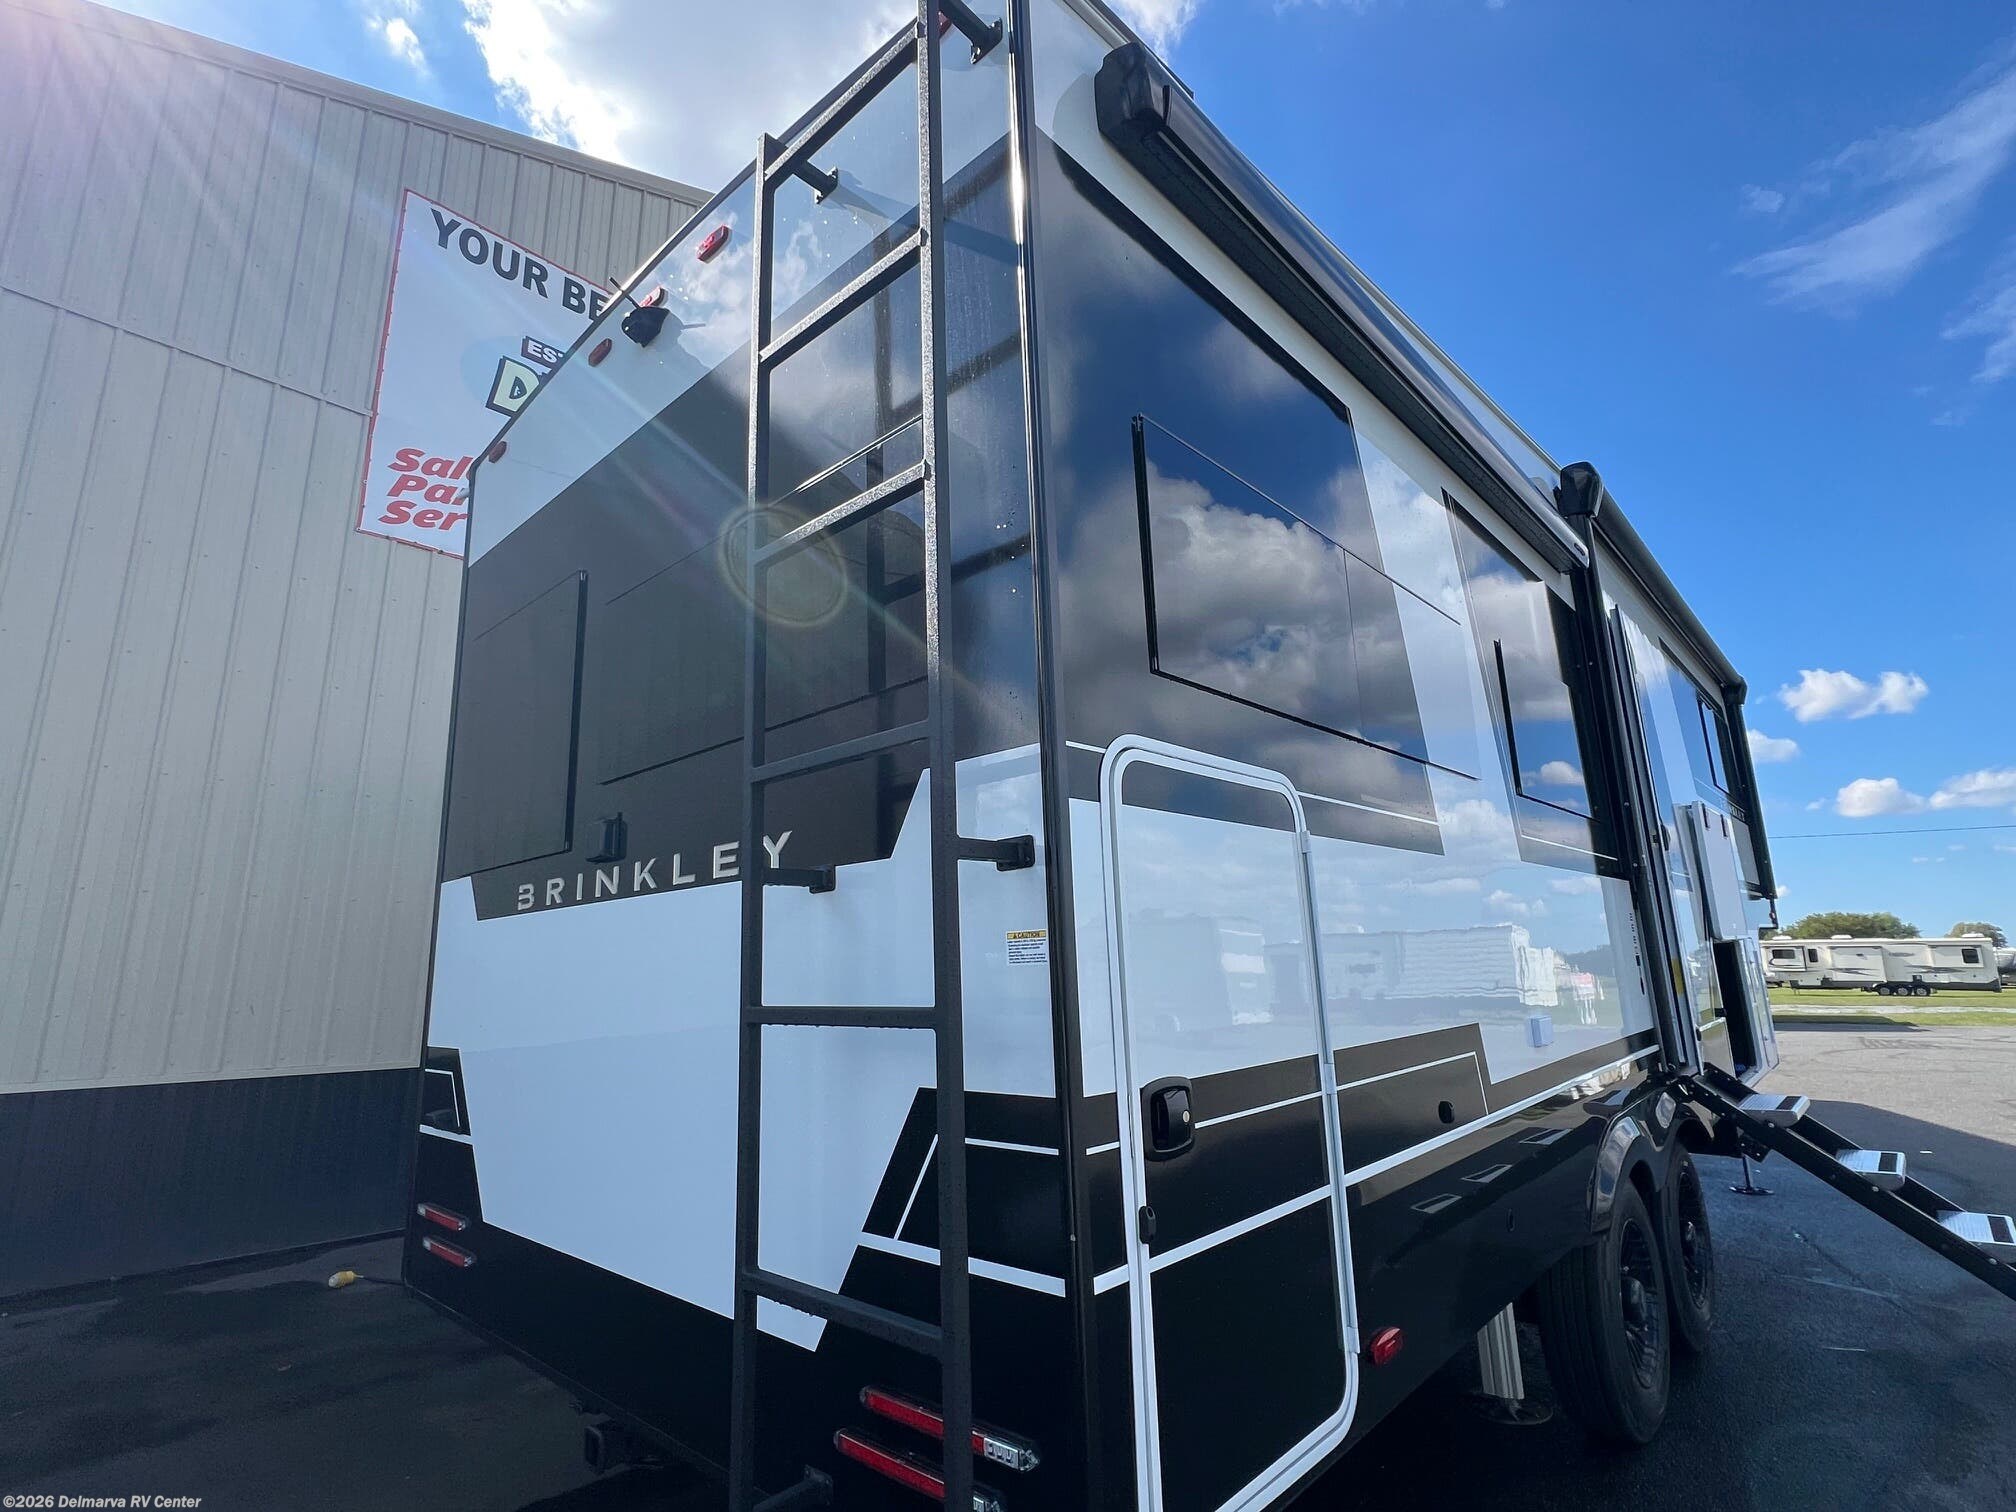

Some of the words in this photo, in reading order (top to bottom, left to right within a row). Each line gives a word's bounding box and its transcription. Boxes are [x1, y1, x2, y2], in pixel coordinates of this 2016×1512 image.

[430, 207, 549, 299] YOUR
[527, 339, 564, 363] ES
[387, 447, 473, 480] Sal
[517, 830, 793, 911] BRINKLEY
